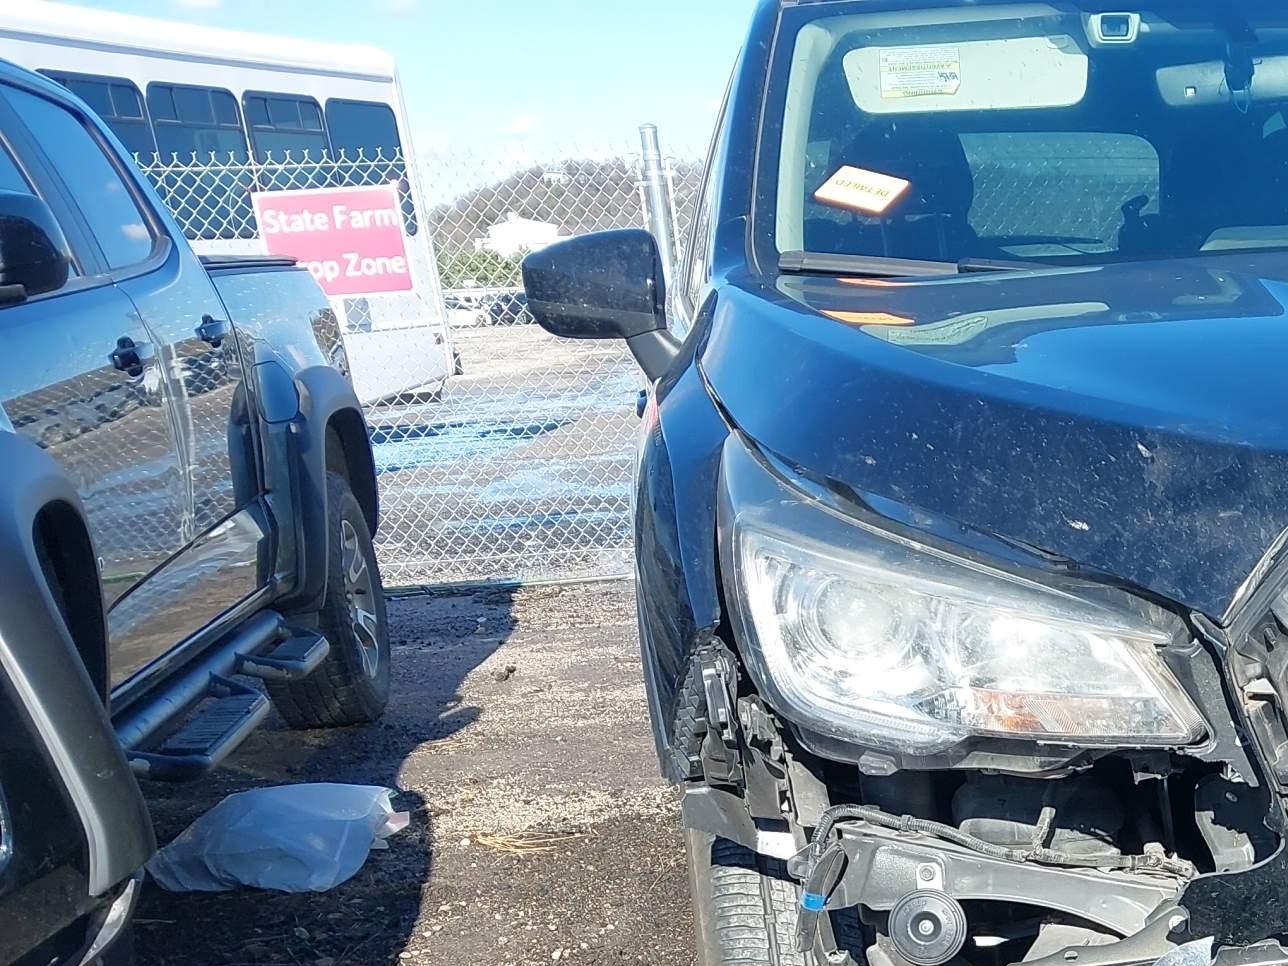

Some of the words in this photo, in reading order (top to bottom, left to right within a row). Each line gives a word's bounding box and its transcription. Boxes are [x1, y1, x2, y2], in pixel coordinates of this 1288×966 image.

[262, 207, 329, 234] State
[332, 204, 399, 230] Farm
[341, 252, 406, 277] Zone
